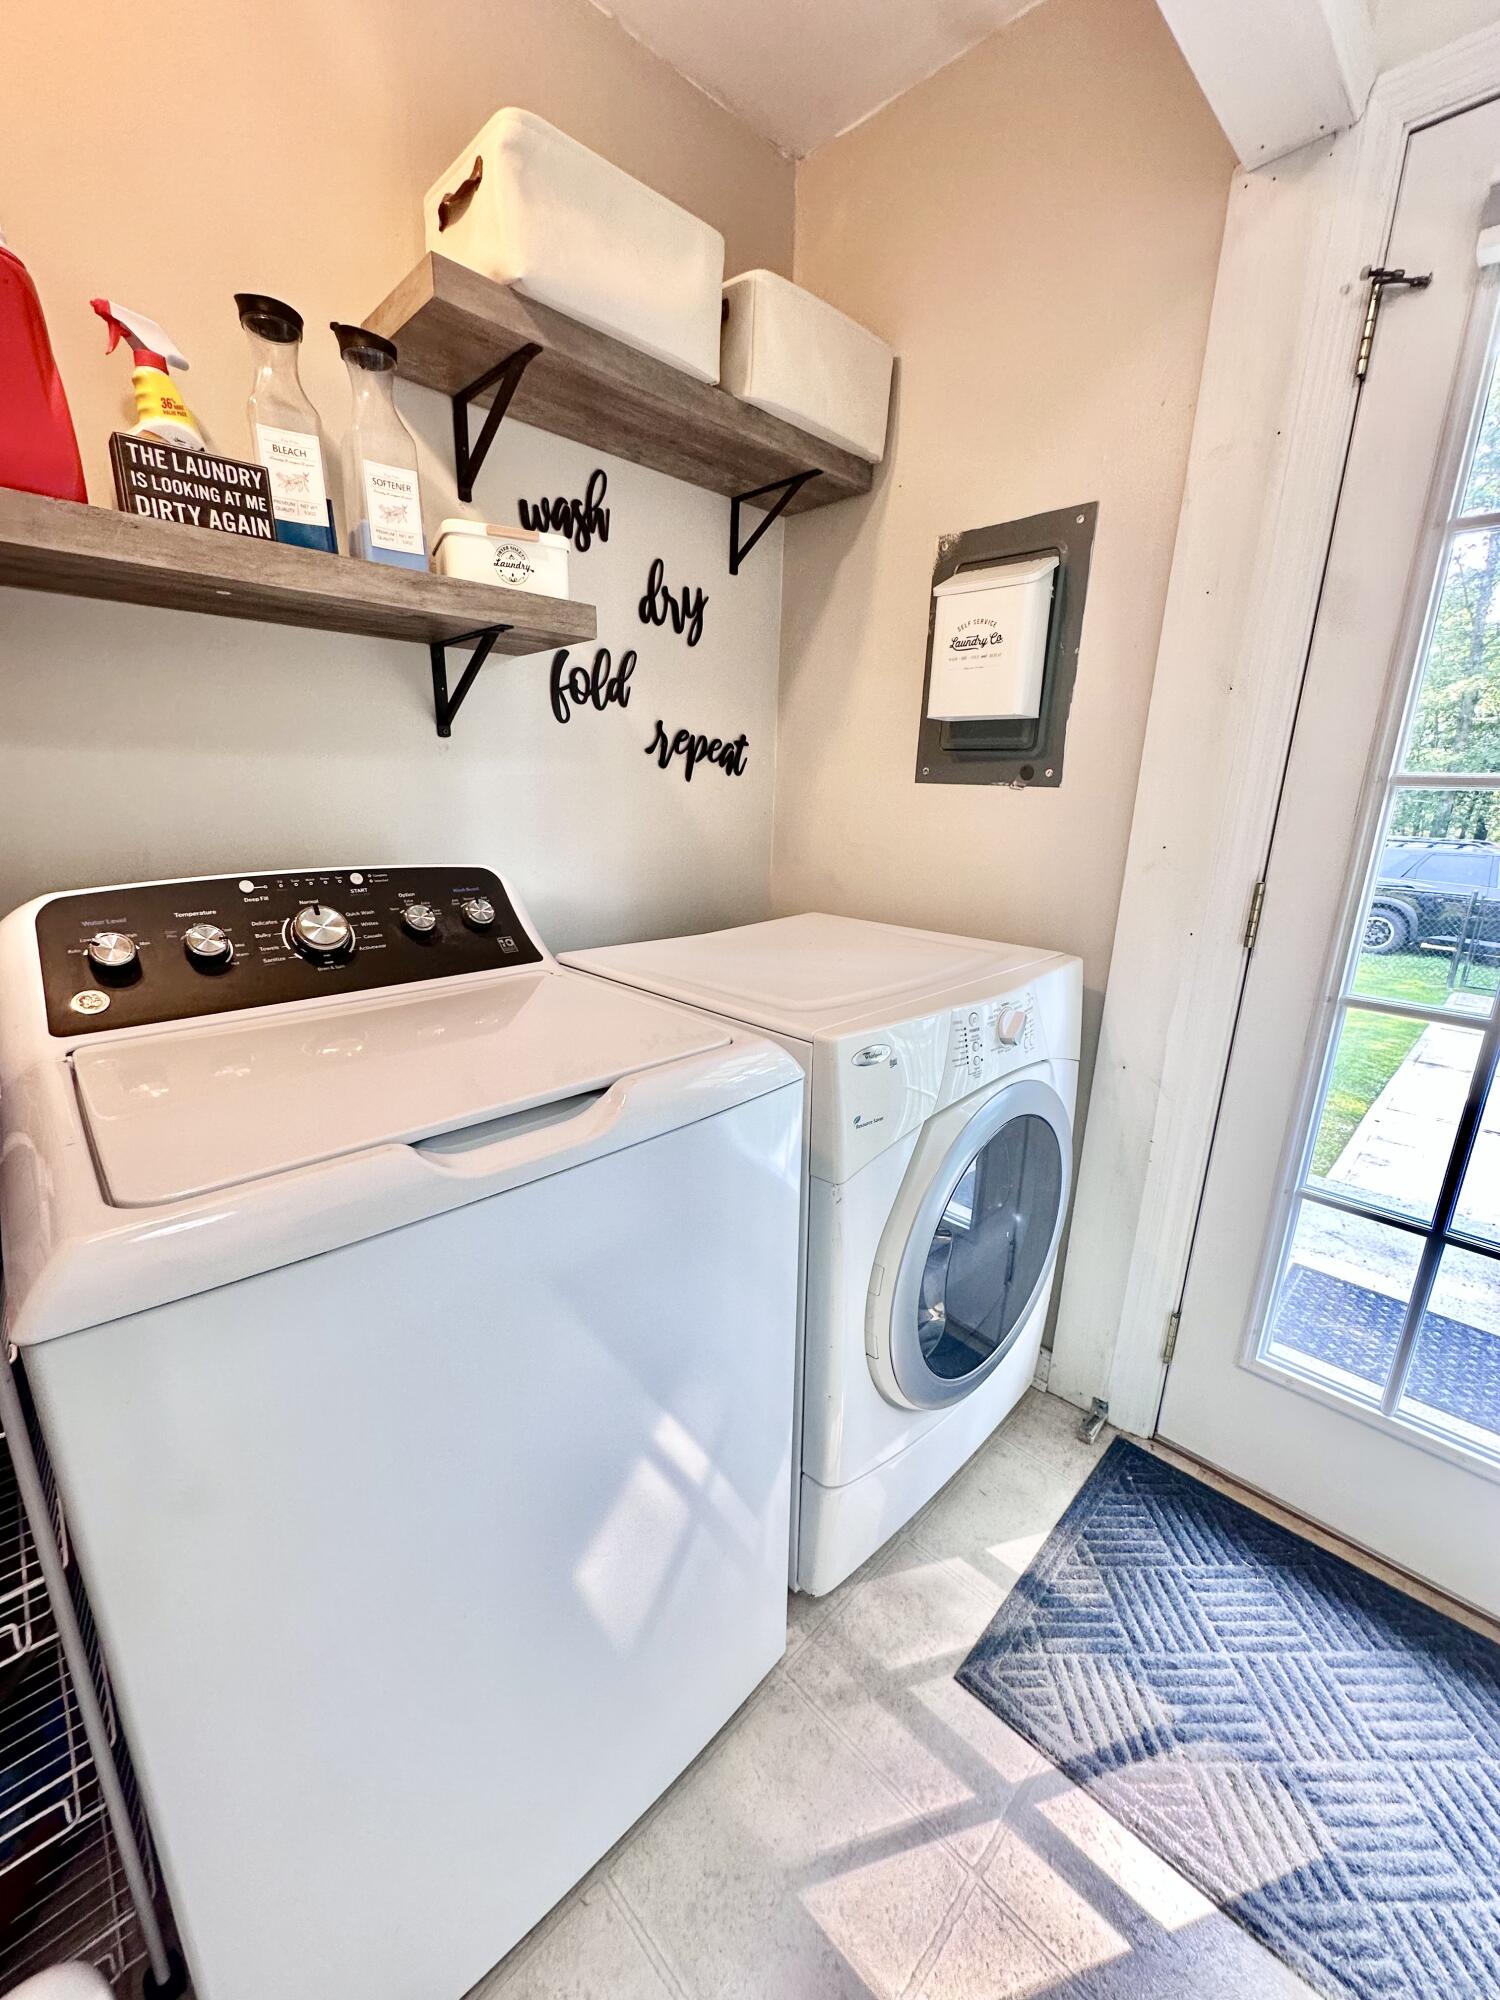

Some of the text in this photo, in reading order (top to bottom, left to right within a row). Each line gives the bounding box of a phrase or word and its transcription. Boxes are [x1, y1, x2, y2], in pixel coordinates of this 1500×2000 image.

[126, 442, 263, 490] THE LAUNDRY
[272, 444, 307, 458] BLEACH
[130, 470, 268, 513] IS LOOKING AT ME
[372, 477, 412, 493] SOFTENER
[135, 496, 272, 539] DIRTY AGAIN
[518, 469, 610, 552] wash
[493, 558, 535, 573] Laundry
[638, 558, 709, 647] dry
[949, 631, 1003, 652] Laundry Co
[957, 618, 998, 632] SELF SERVICE
[550, 648, 637, 724] fold
[644, 720, 749, 783] repeat
[174, 910, 217, 918] Temperature
